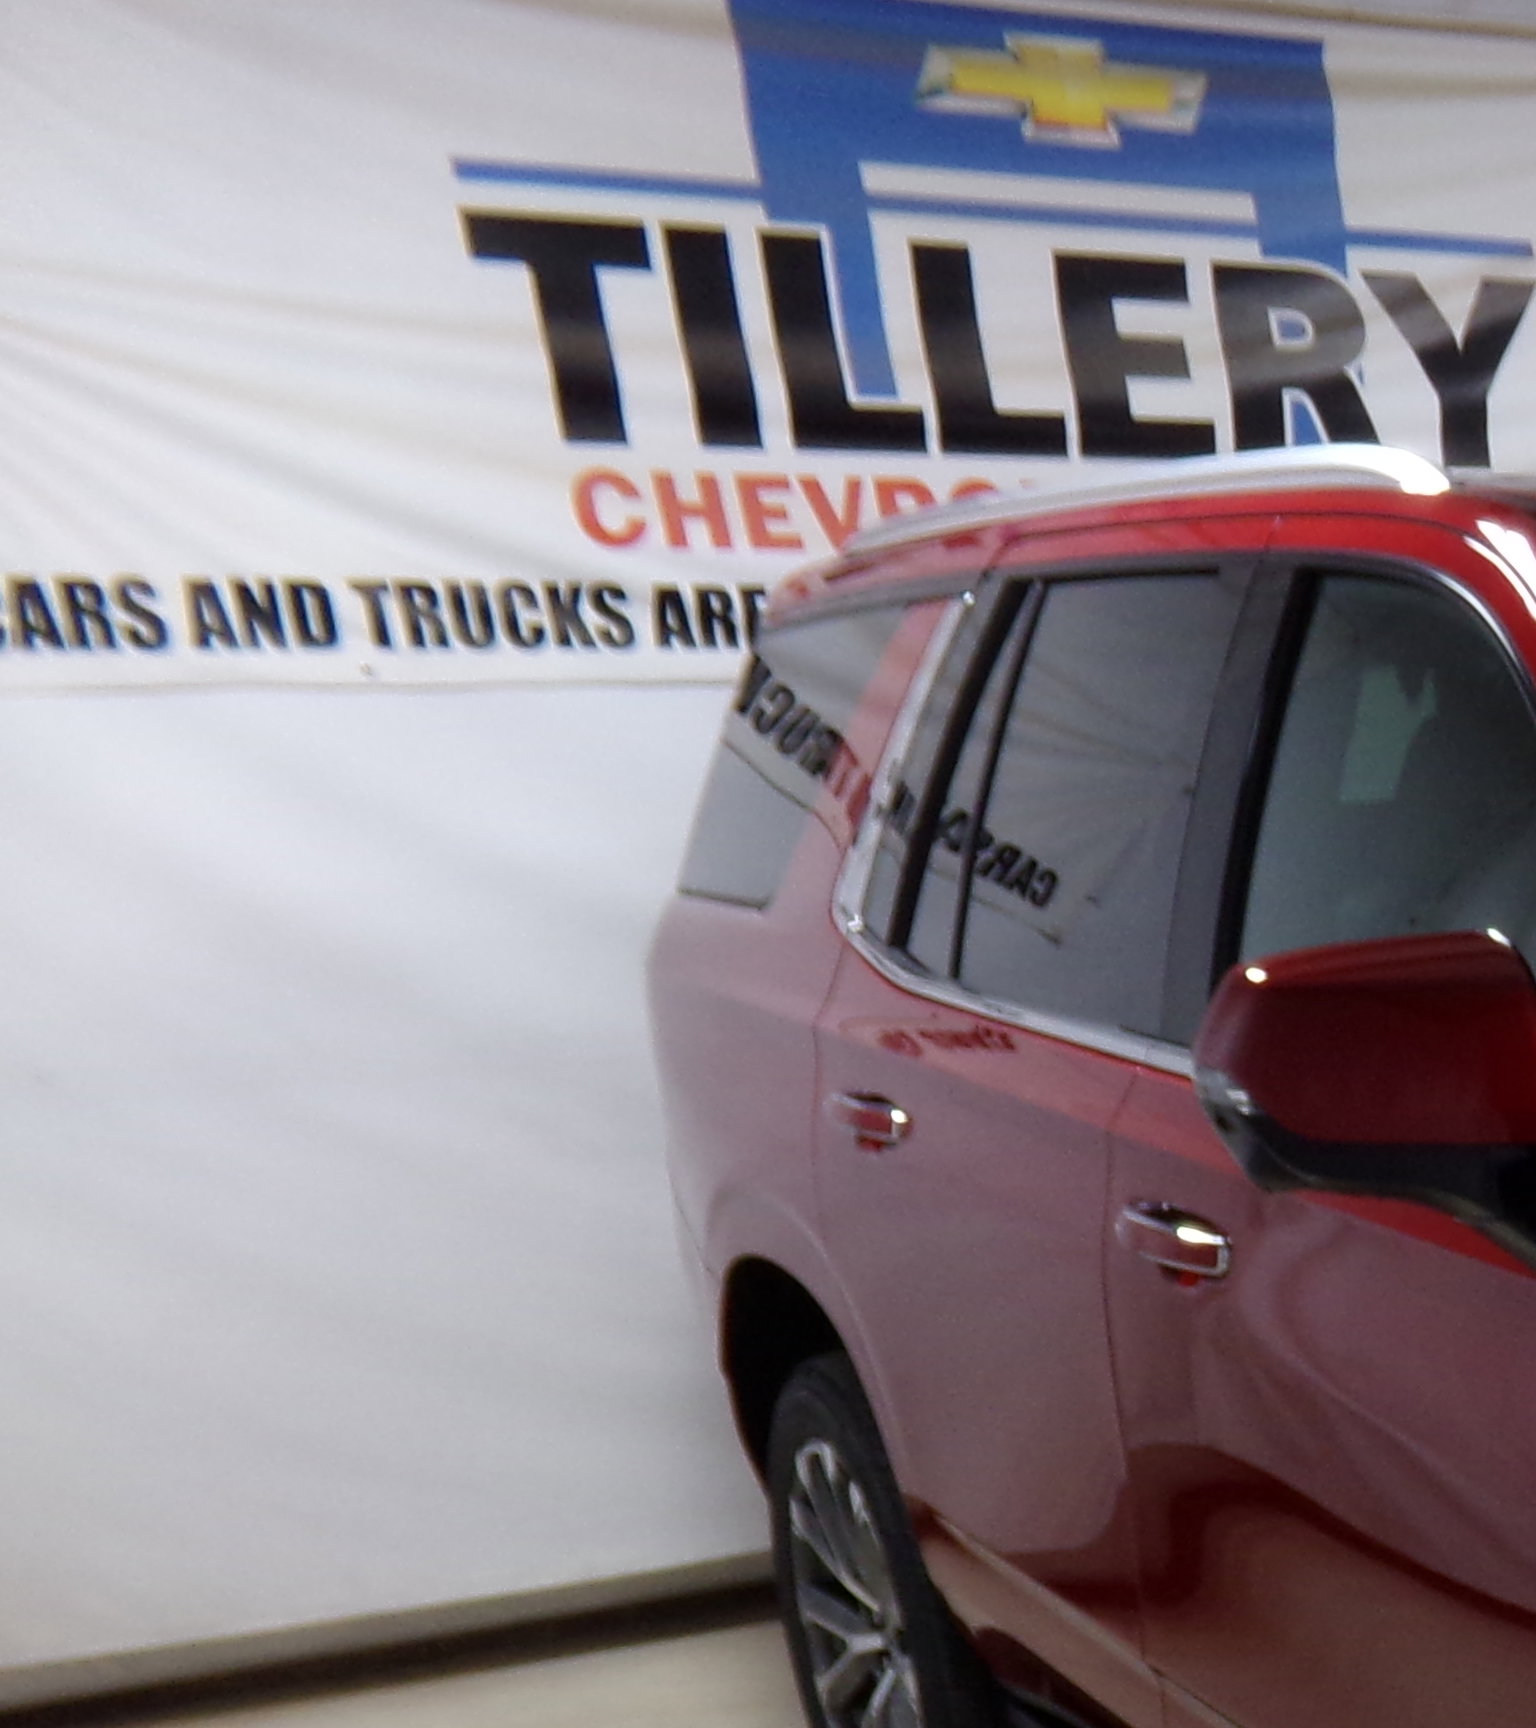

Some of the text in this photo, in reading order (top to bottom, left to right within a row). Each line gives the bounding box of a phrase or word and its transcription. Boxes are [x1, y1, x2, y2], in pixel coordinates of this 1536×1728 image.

[0, 572, 170, 651] ARS
[181, 573, 339, 650] AND
[345, 576, 635, 652] TRUCKS
